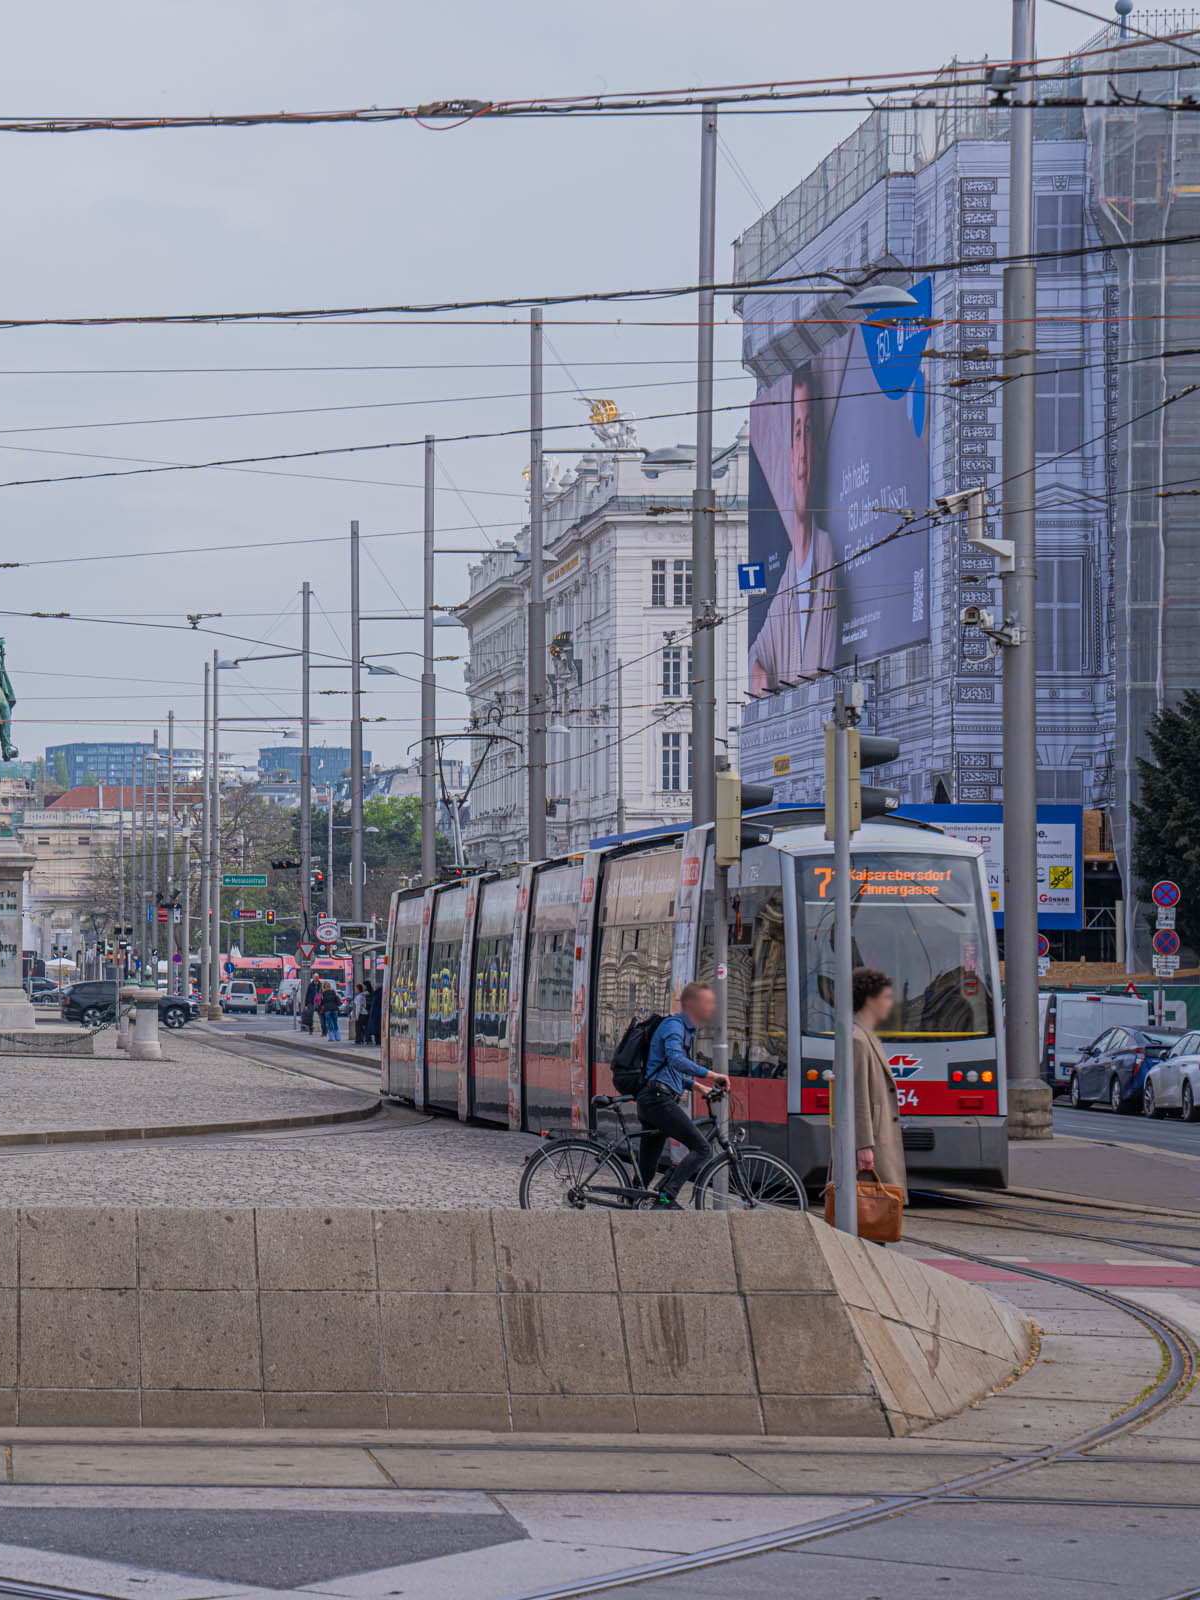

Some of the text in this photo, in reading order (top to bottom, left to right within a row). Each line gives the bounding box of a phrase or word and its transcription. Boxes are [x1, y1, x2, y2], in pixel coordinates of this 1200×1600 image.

[852, 458, 870, 488] habe
[859, 495, 879, 526] Jahre
[742, 566, 760, 587] T
[849, 868, 952, 881] Kaiserebersdorf
[8, 889, 17, 898] der
[859, 884, 940, 897] Zinnergasse
[898, 1089, 918, 1107] 54
